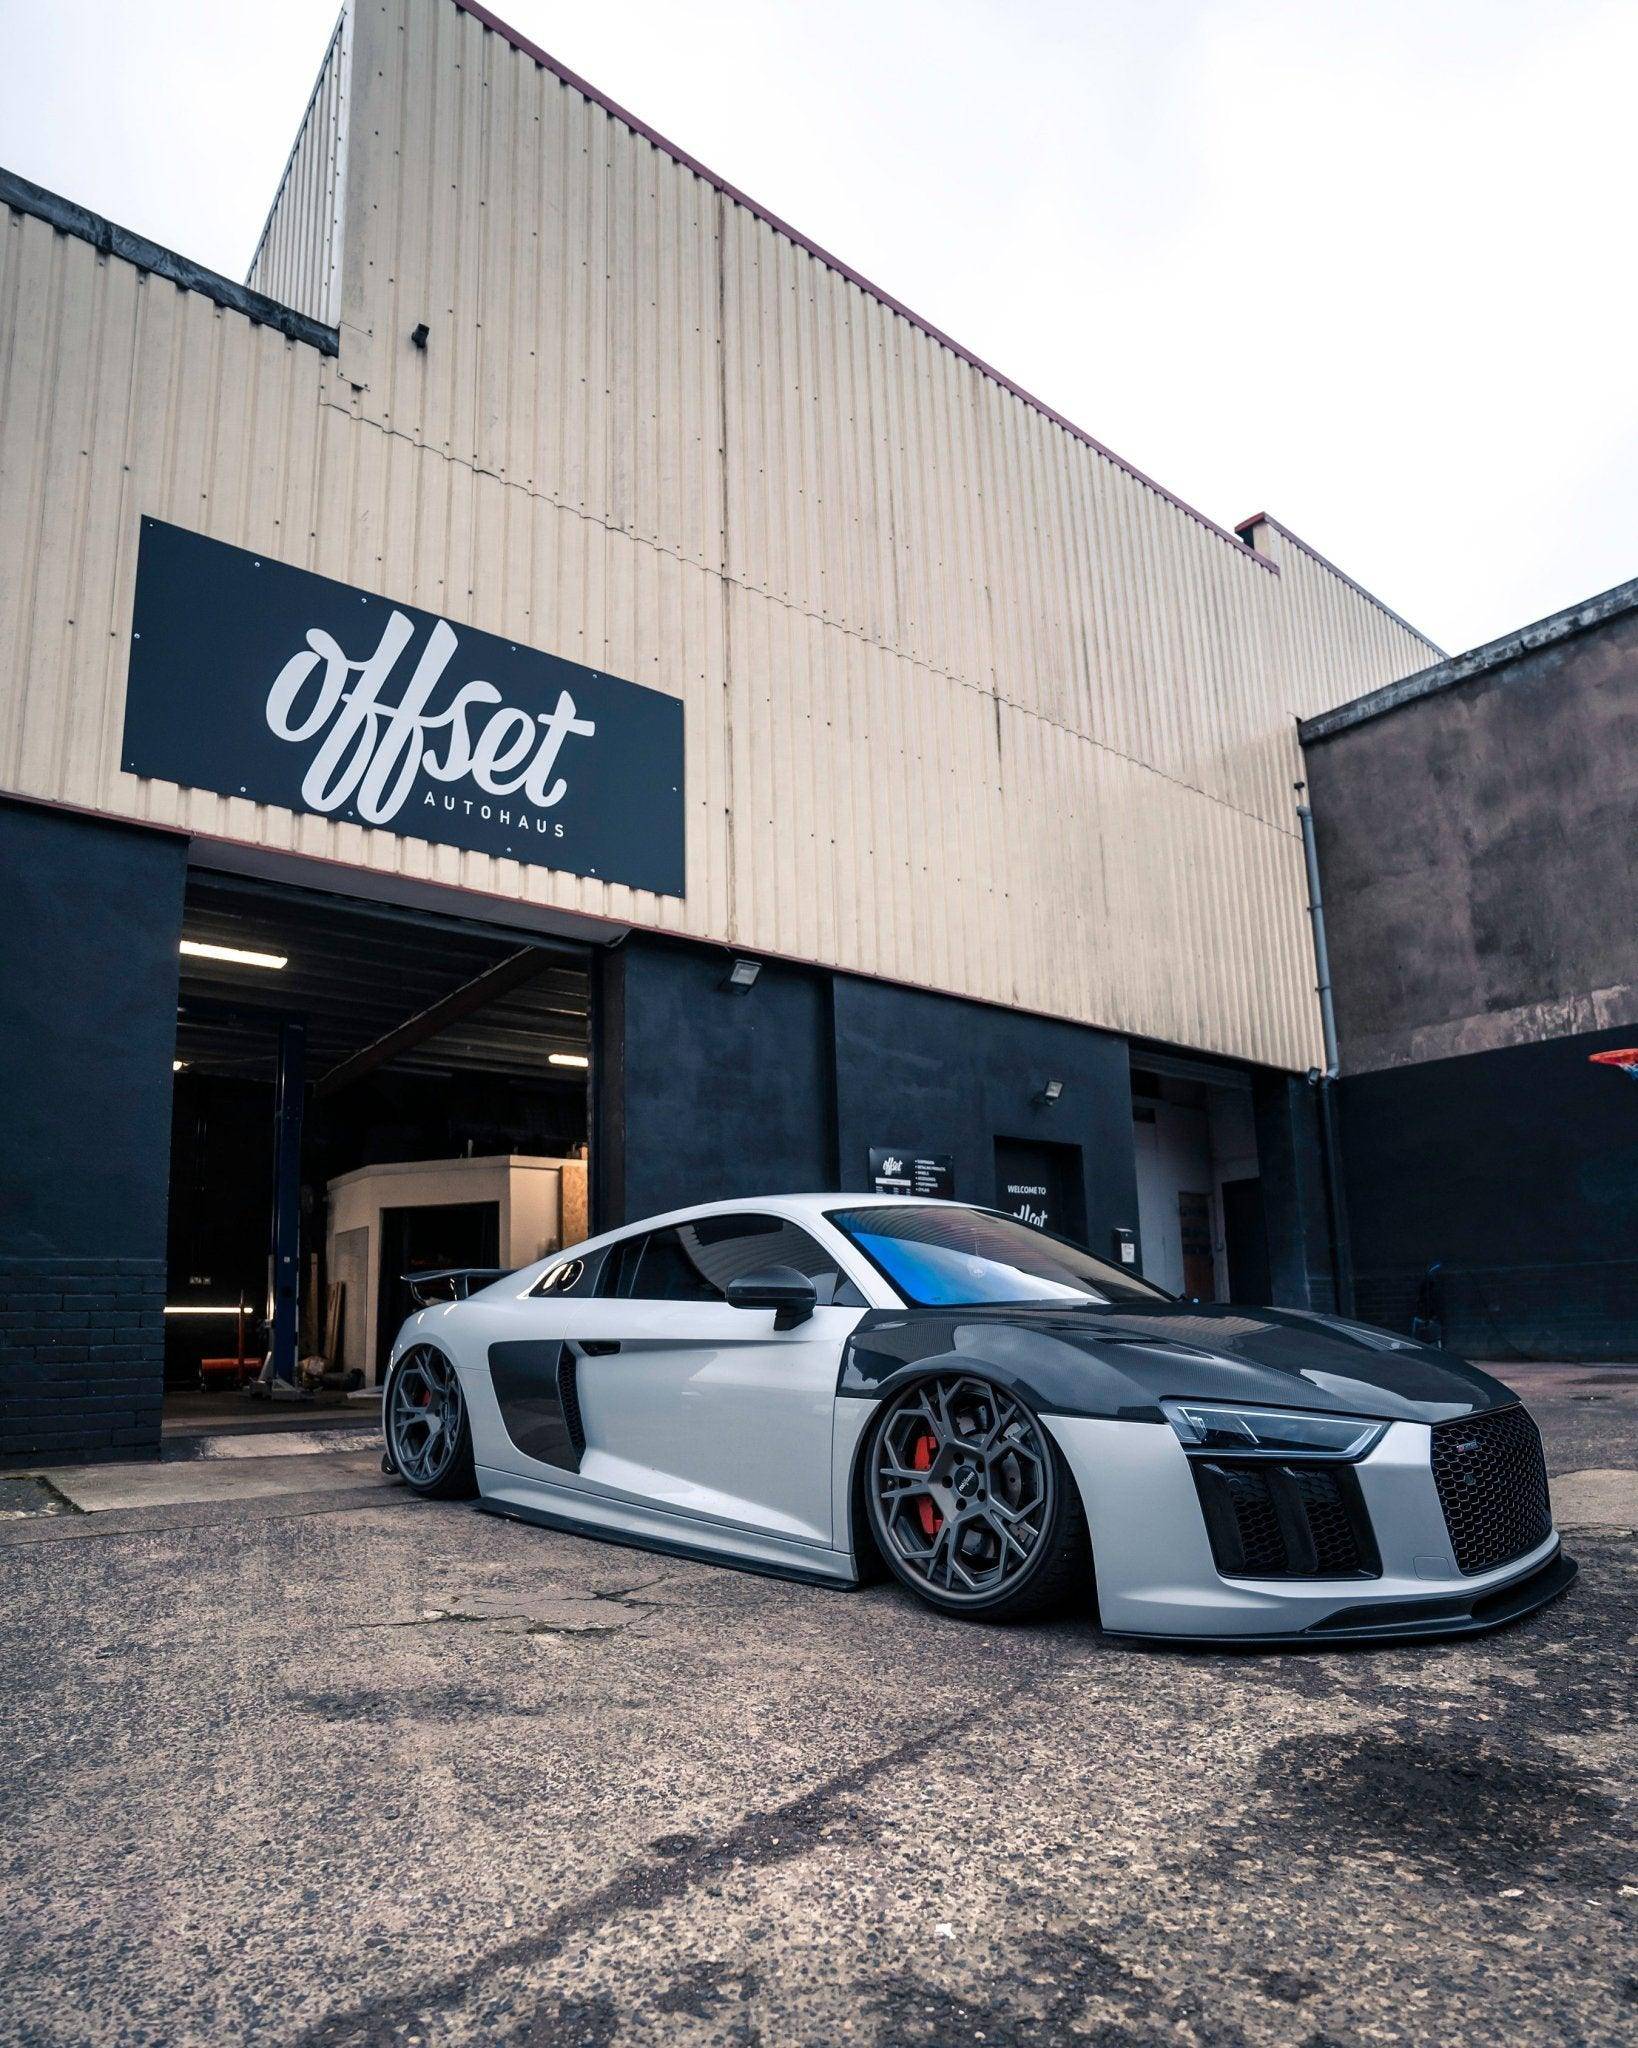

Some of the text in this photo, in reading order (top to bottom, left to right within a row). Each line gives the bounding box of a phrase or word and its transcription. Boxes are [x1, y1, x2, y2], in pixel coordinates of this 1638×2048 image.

[265, 609, 596, 825] offset
[423, 791, 565, 838] AUTOHAUS
[1007, 1184, 1047, 1195] WELCOME TO
[1012, 1204, 1047, 1227] set
